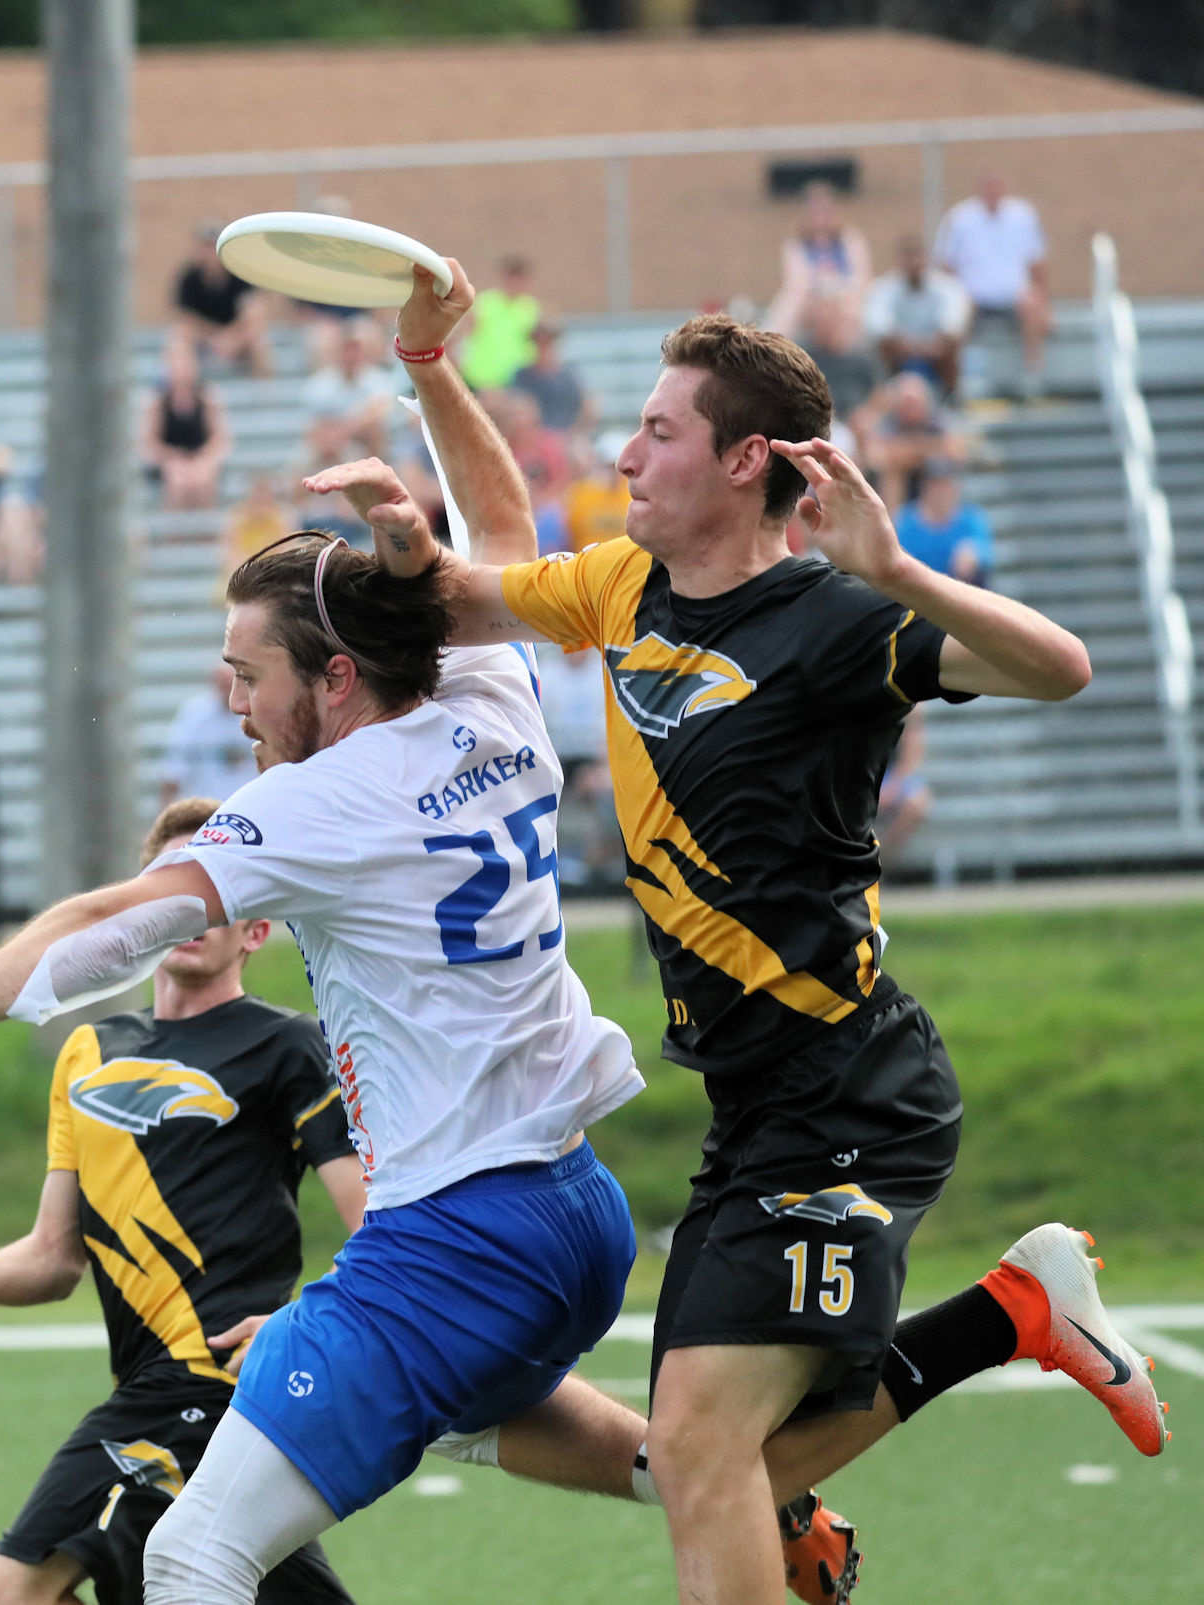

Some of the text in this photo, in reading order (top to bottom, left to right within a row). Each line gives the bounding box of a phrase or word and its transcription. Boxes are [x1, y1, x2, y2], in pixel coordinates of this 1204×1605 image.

[417, 745, 535, 820] BARKER
[423, 793, 563, 965] 25
[783, 1241, 855, 1316] 15
